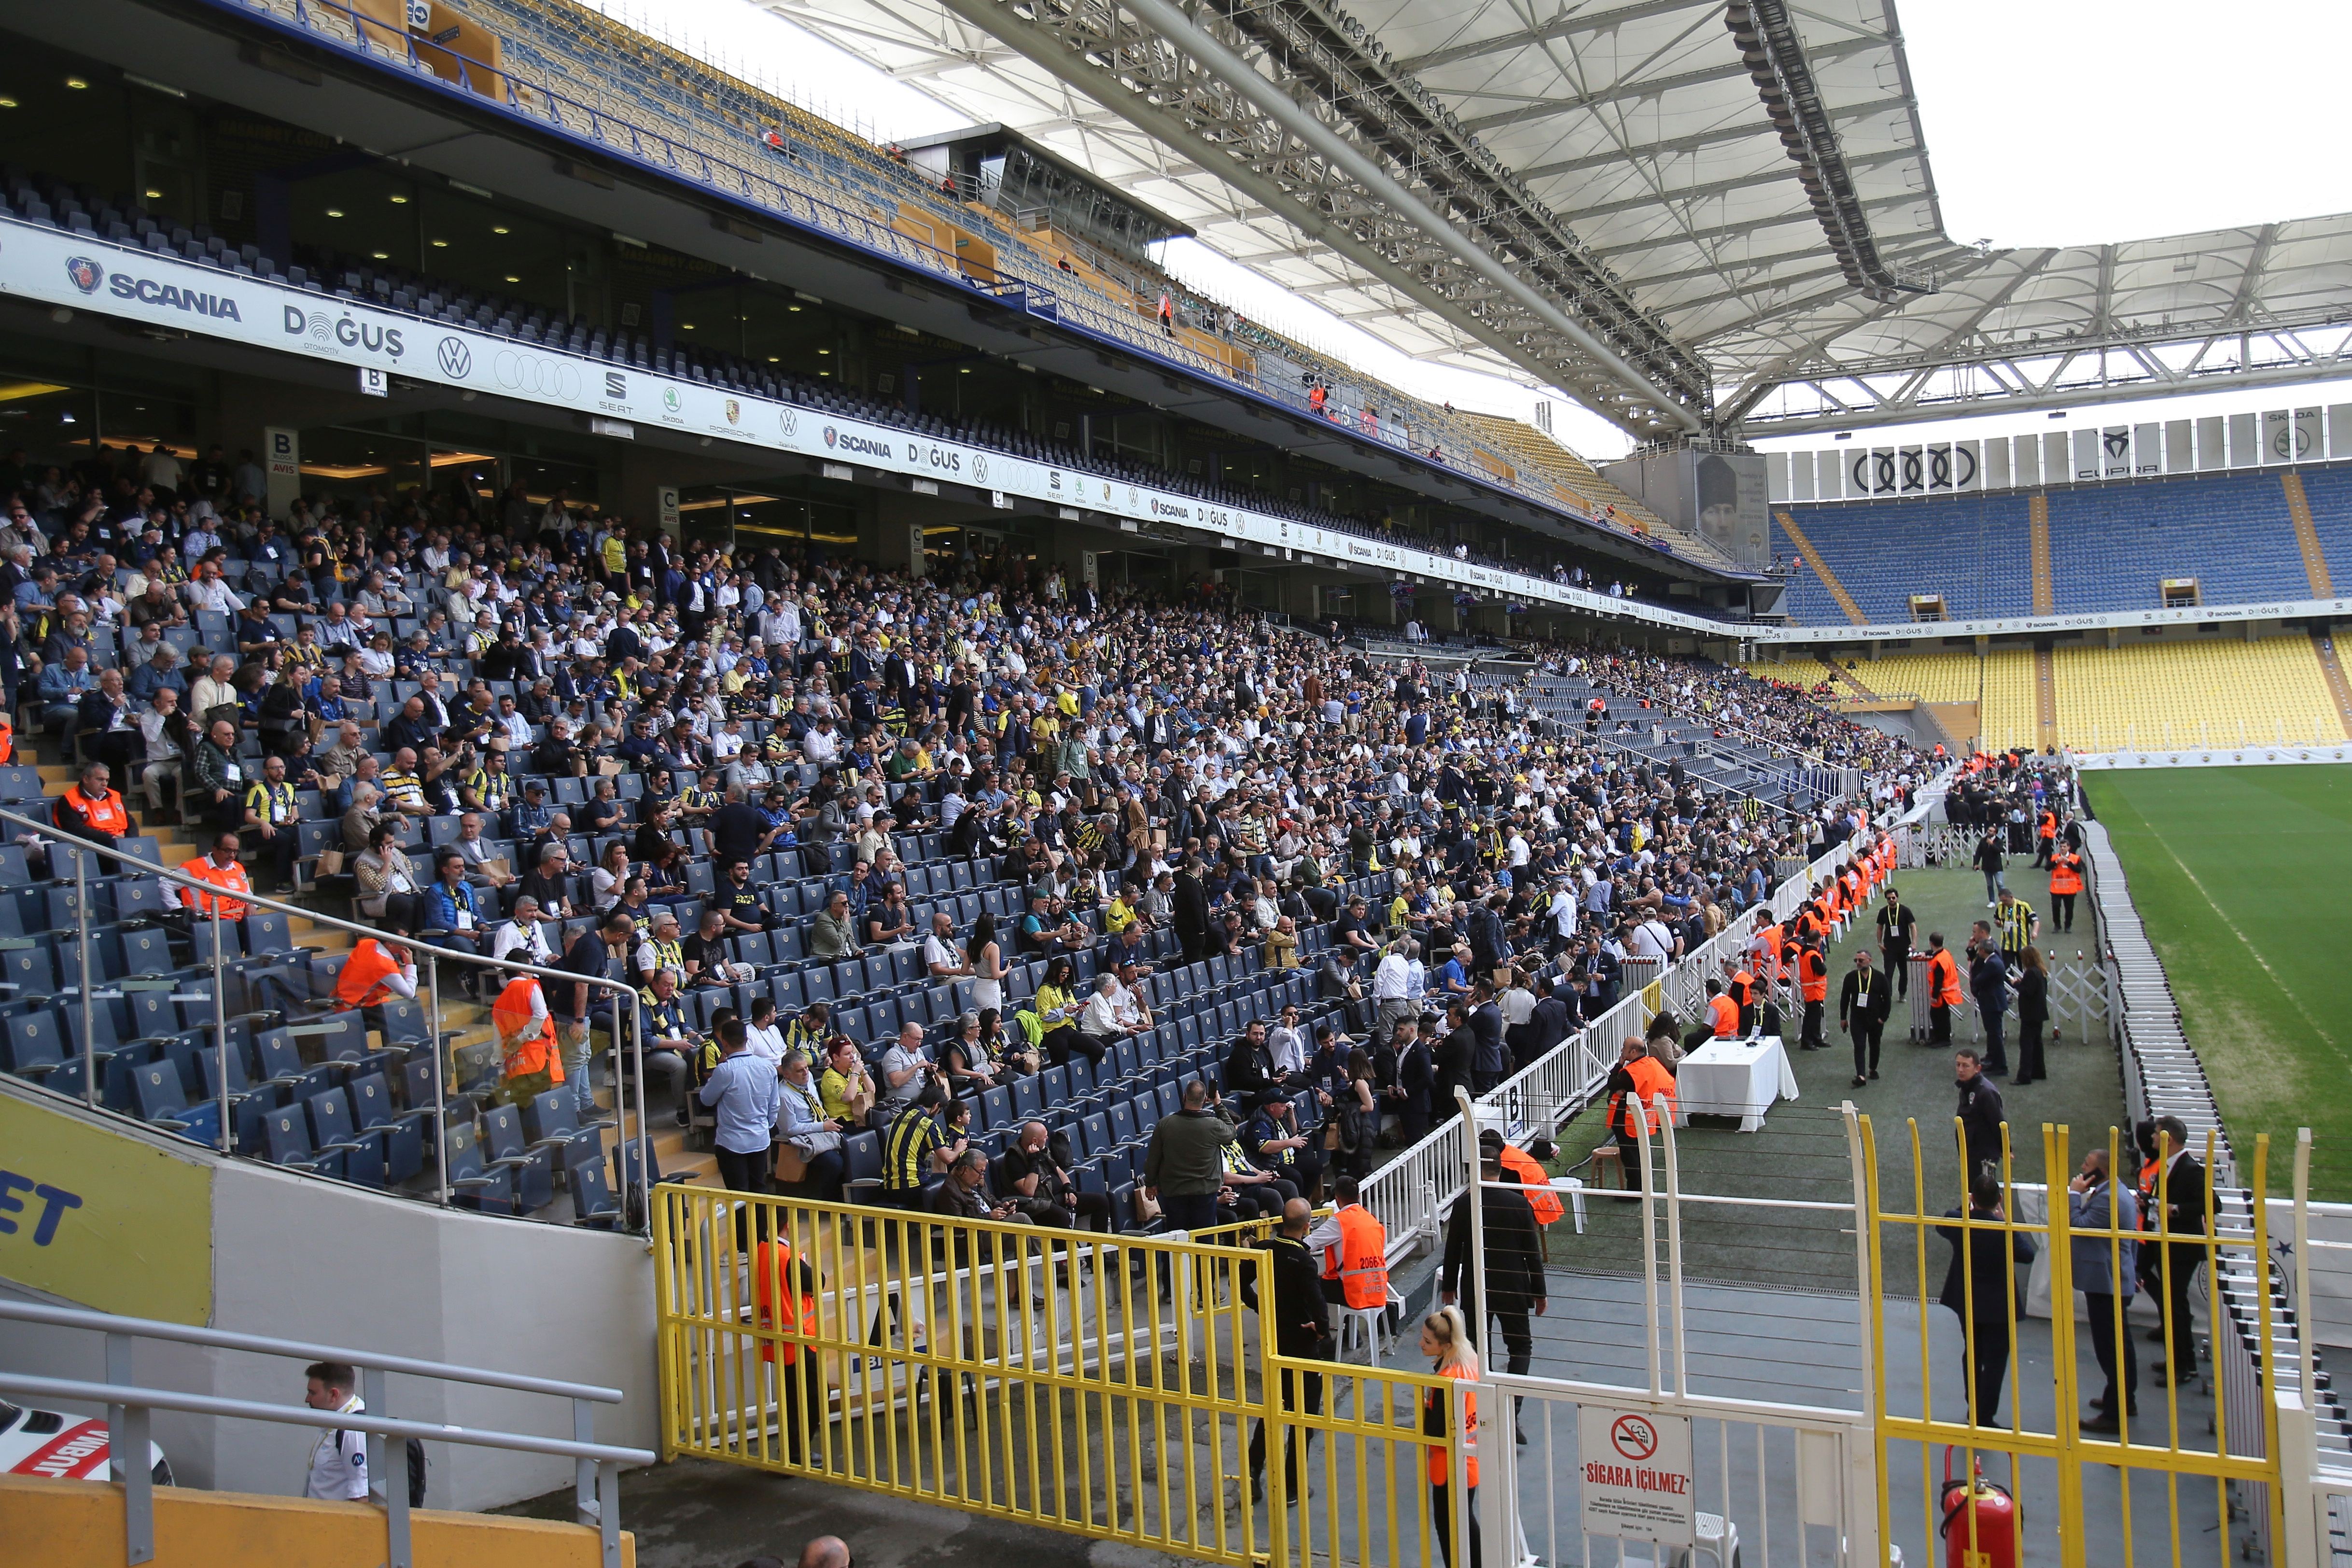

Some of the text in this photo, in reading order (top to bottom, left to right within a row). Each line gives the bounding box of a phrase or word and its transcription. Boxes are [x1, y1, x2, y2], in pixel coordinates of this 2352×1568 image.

[109, 273, 242, 323] SCANIA
[284, 306, 405, 364] DOĞUŞ
[369, 369, 380, 387] B
[365, 387, 384, 396] Blocks
[599, 401, 634, 415] SEAT
[662, 415, 684, 424] ŠKODA
[2268, 412, 2315, 422] ŠKDA
[709, 425, 756, 440] PORSCHE
[275, 434, 291, 454] B
[839, 434, 892, 459] SCANIA
[273, 463, 294, 474] AVIS
[665, 492, 674, 508] C
[995, 491, 1001, 502] C
[1047, 491, 1064, 500] SEAT
[1160, 503, 1189, 519] SCANIA
[913, 528, 921, 541] C
[1354, 546, 1372, 558] SCANIA
[1088, 554, 1093, 565] D
[413, 659, 429, 668] AVIS
[1509, 1085, 1519, 1122] B
[1586, 1460, 1686, 1495] SİGARA İÇİLMEZ
